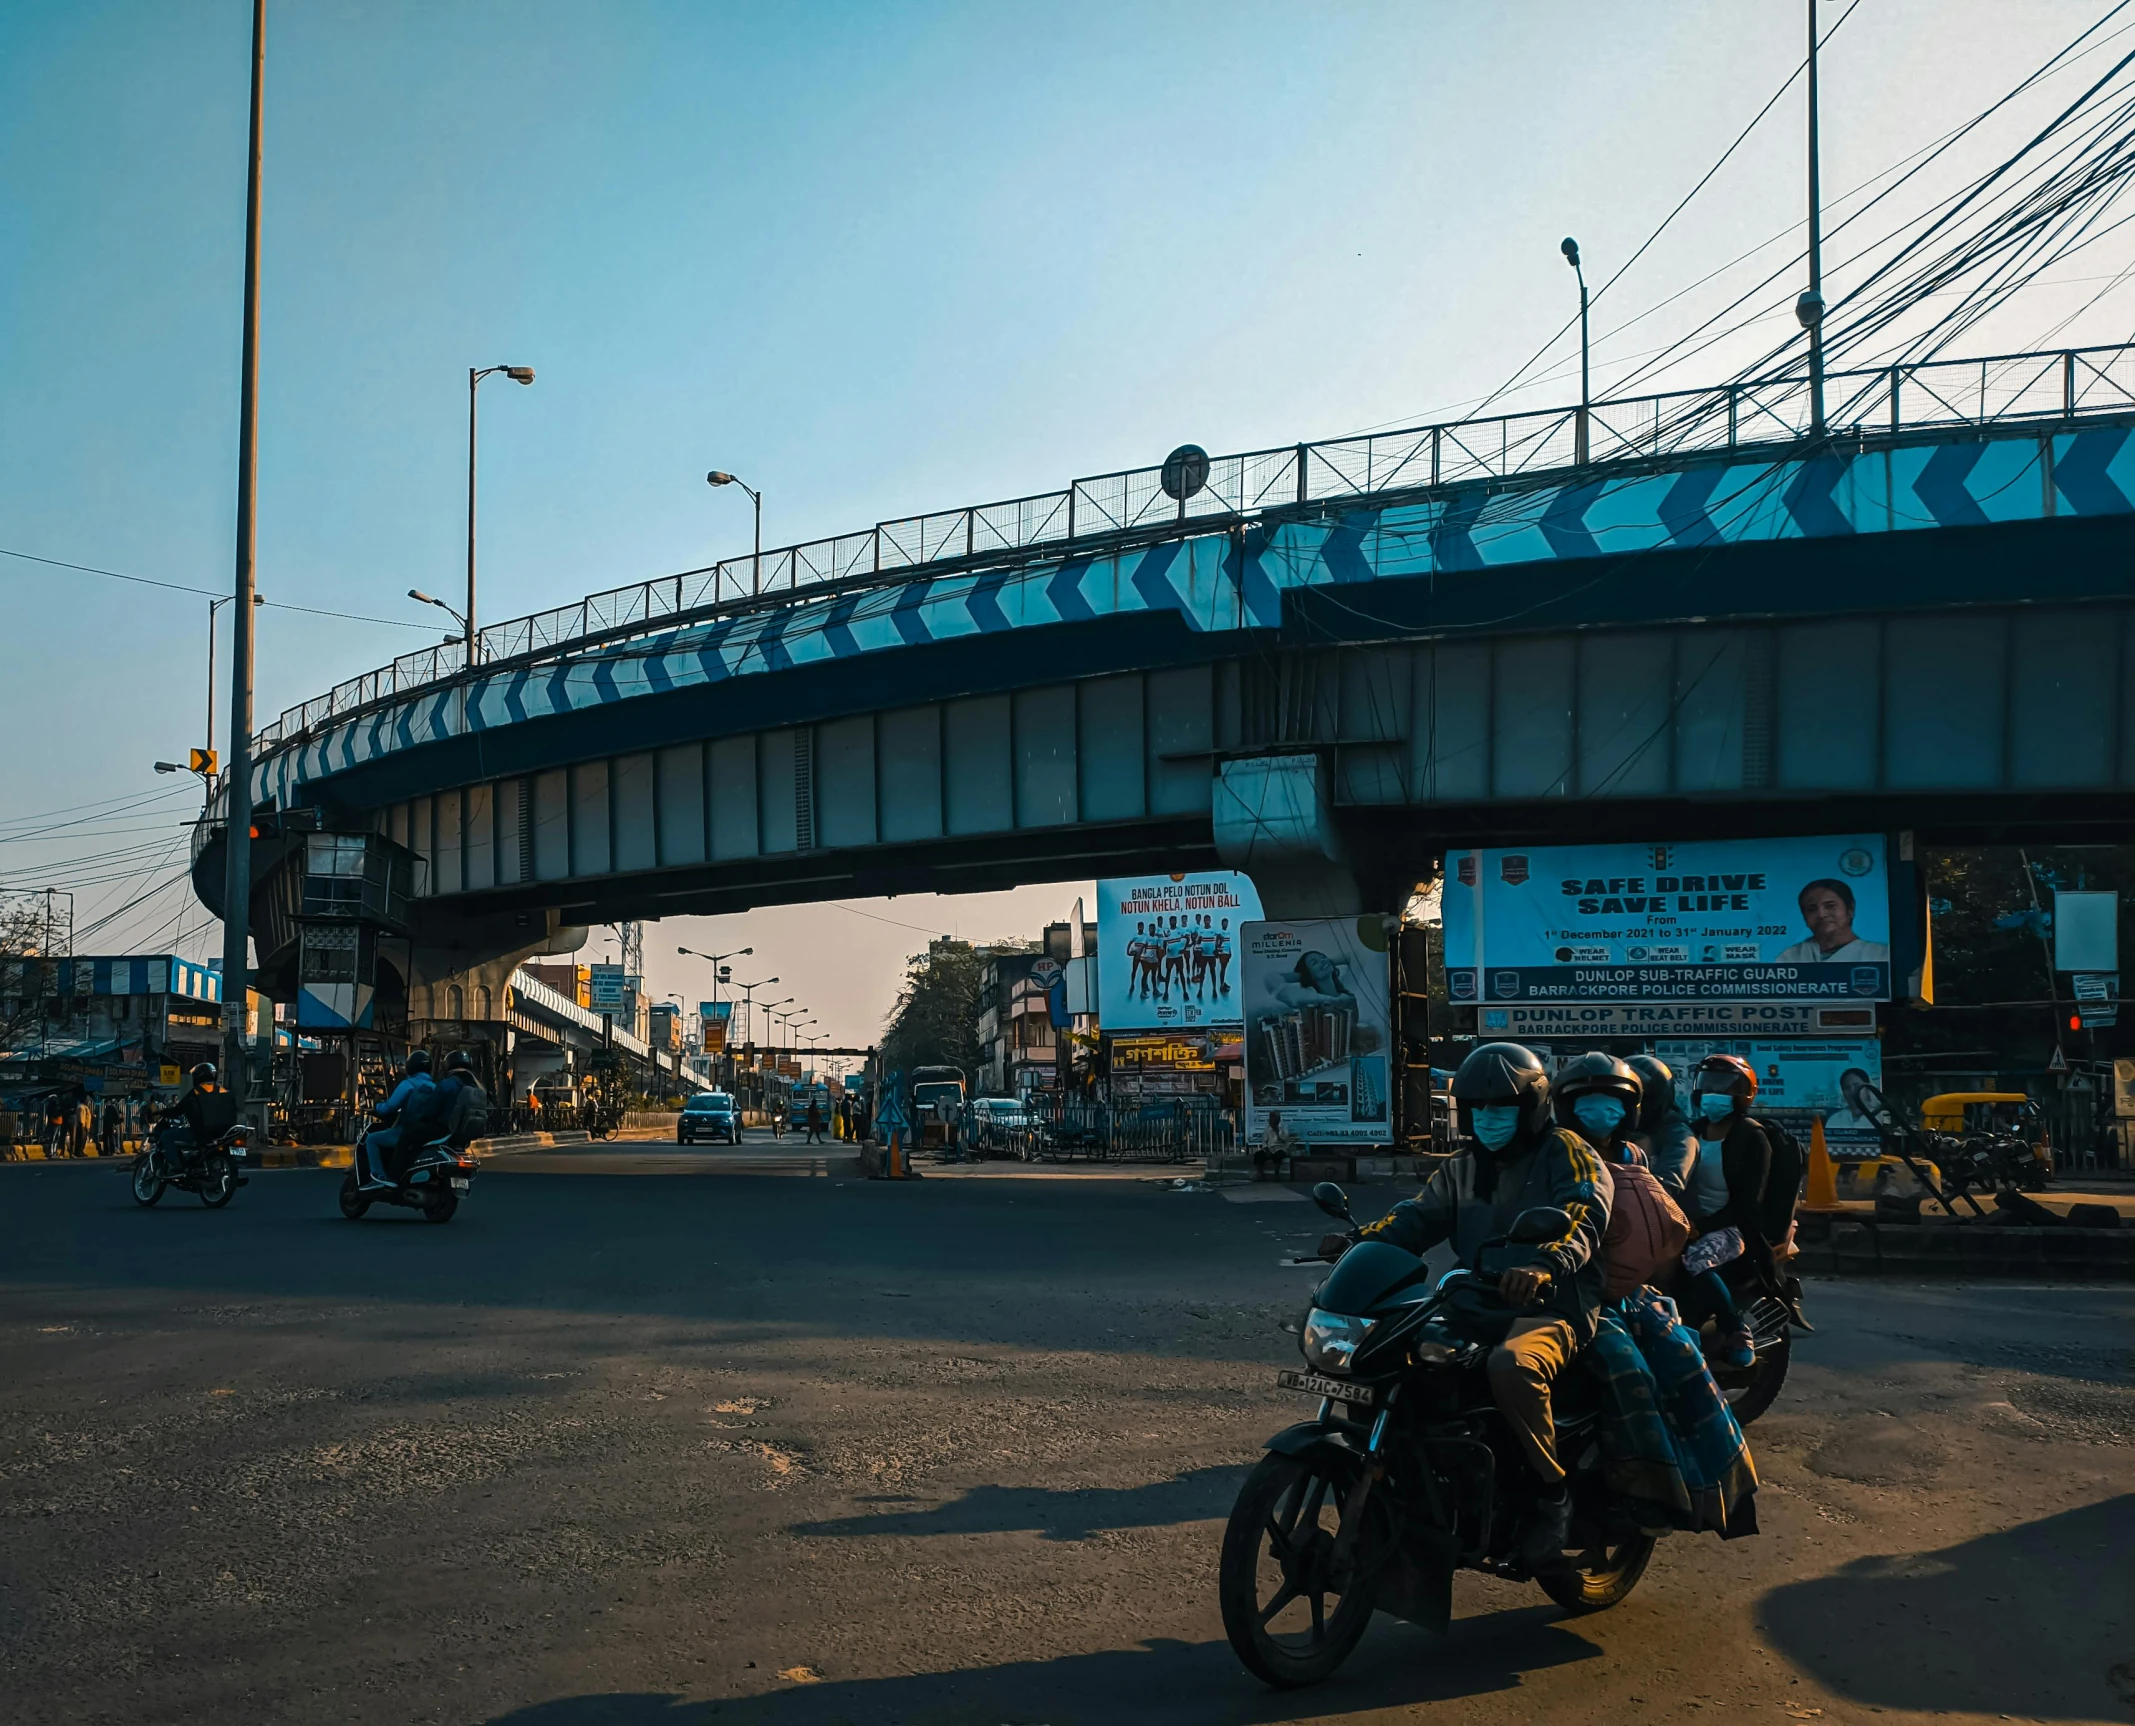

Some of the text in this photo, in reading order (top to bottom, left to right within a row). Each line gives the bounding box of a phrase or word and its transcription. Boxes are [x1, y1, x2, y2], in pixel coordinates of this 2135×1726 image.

[1131, 882, 1229, 900] BANGLA PELO NOTUN DOL
[1561, 873, 1766, 896] SAFE DRIVE
[1121, 894, 1240, 914] NOTUN KHELA, NOTUN BALL
[1578, 893, 1749, 914] SAVE LIFE
[1646, 915, 1677, 925] From
[1561, 929, 1622, 940] December
[1626, 928, 1654, 938] 2021
[1659, 928, 1671, 938] to
[1675, 927, 1697, 937] 31st
[1701, 926, 1752, 938] January
[1757, 925, 1787, 935] 2022
[1252, 939, 1302, 948] MILLENIA
[1037, 962, 1053, 971] HP
[1575, 967, 1798, 982] DUNLOP SUB-TRAFFIC GUARD
[1529, 984, 1638, 997] BARRACKPORE
[1642, 983, 1696, 996] POLICE
[1700, 981, 1848, 995] COMMISSIONERATE
[1512, 1006, 1814, 1023] DUNLOP TRAFFIC POST
[1518, 1021, 1809, 1035] BARRACKPORE POLICE COMMISSIONERATE
